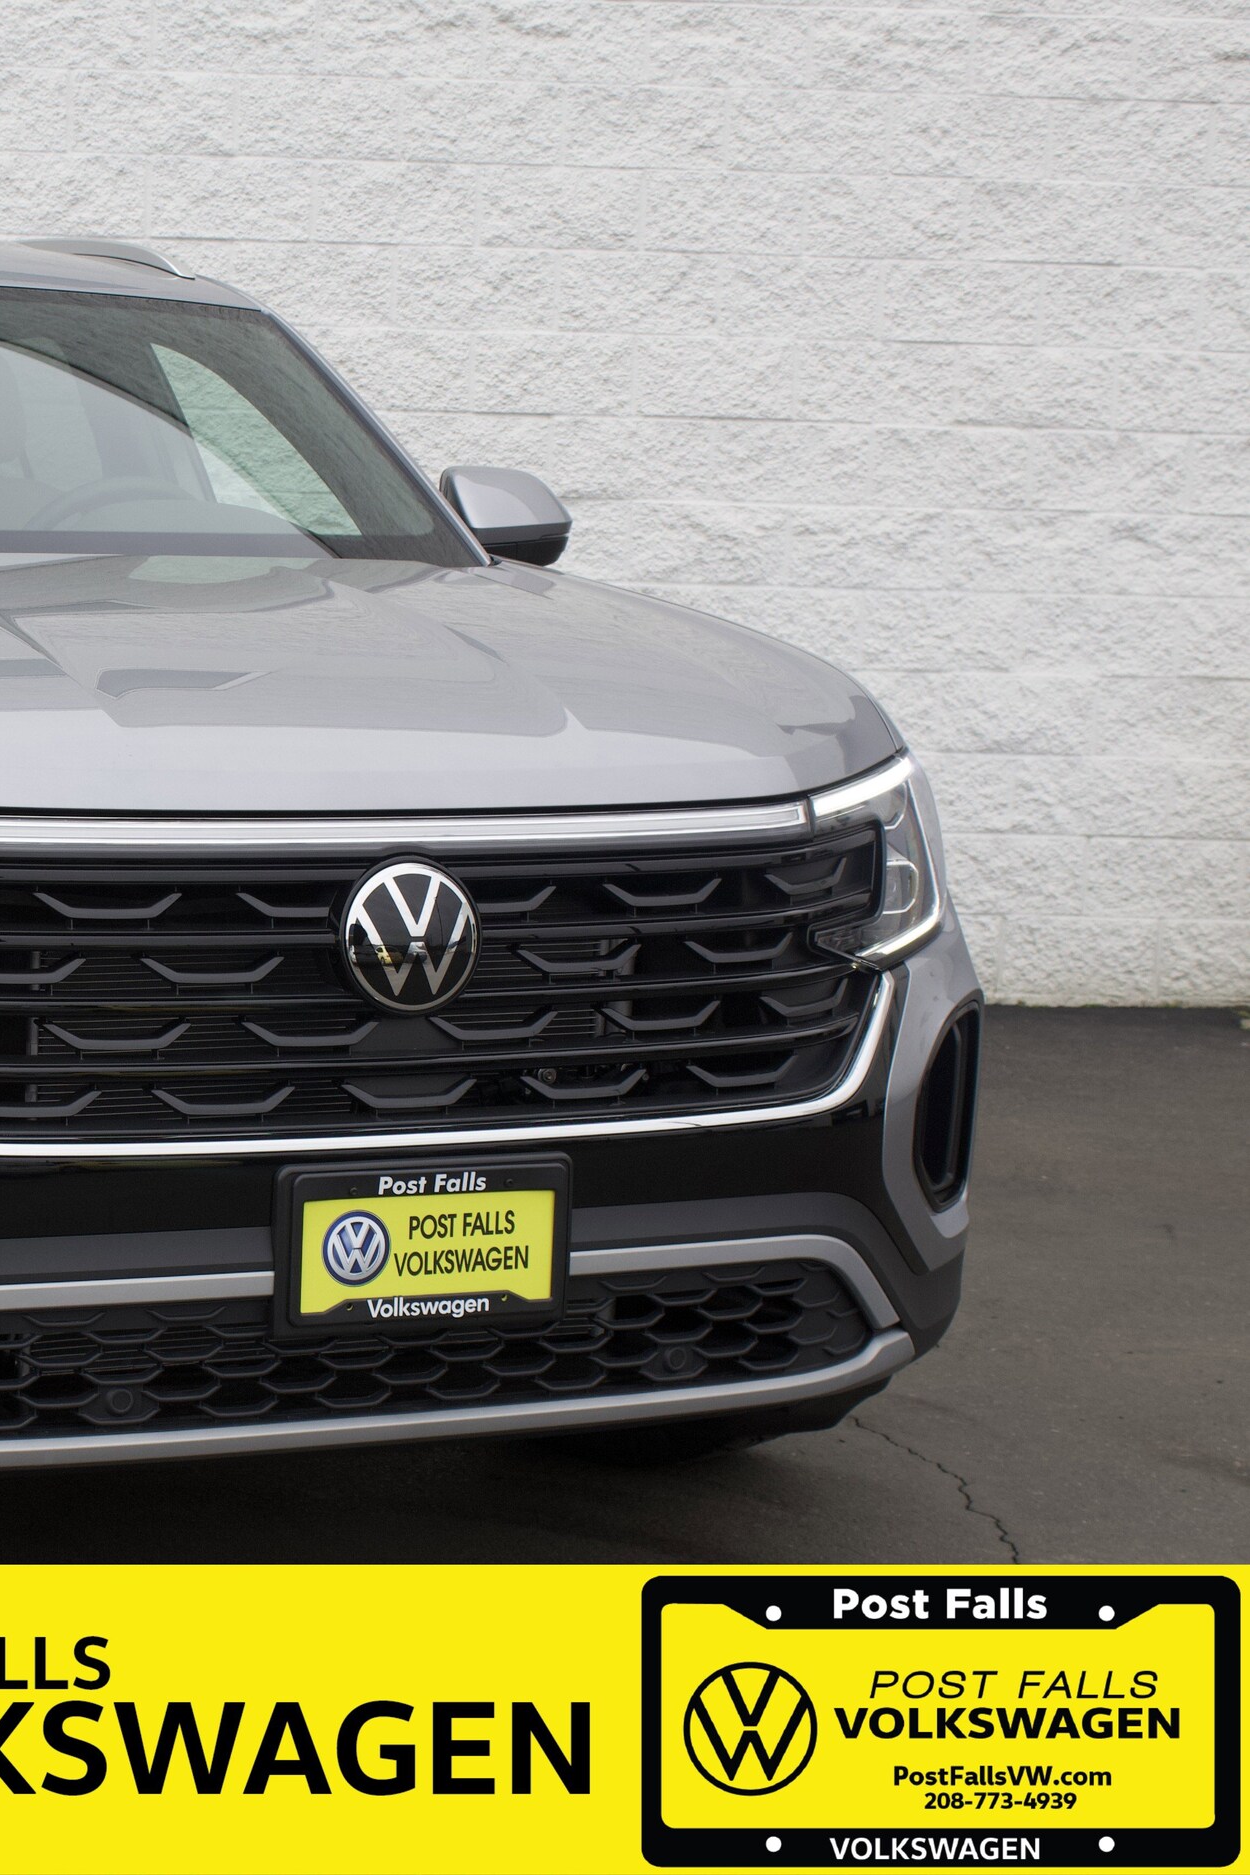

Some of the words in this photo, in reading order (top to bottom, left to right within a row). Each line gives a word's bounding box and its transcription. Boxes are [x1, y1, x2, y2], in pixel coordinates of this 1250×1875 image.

[346, 862, 478, 1012] VW
[378, 1176, 427, 1196] Post
[434, 1171, 486, 1193] Falls
[408, 1213, 457, 1240] POST
[462, 1210, 515, 1236] FALLS
[323, 1210, 391, 1287] VW
[394, 1245, 529, 1277] VOLKSWAGEN
[367, 1296, 490, 1318] Volkswagen
